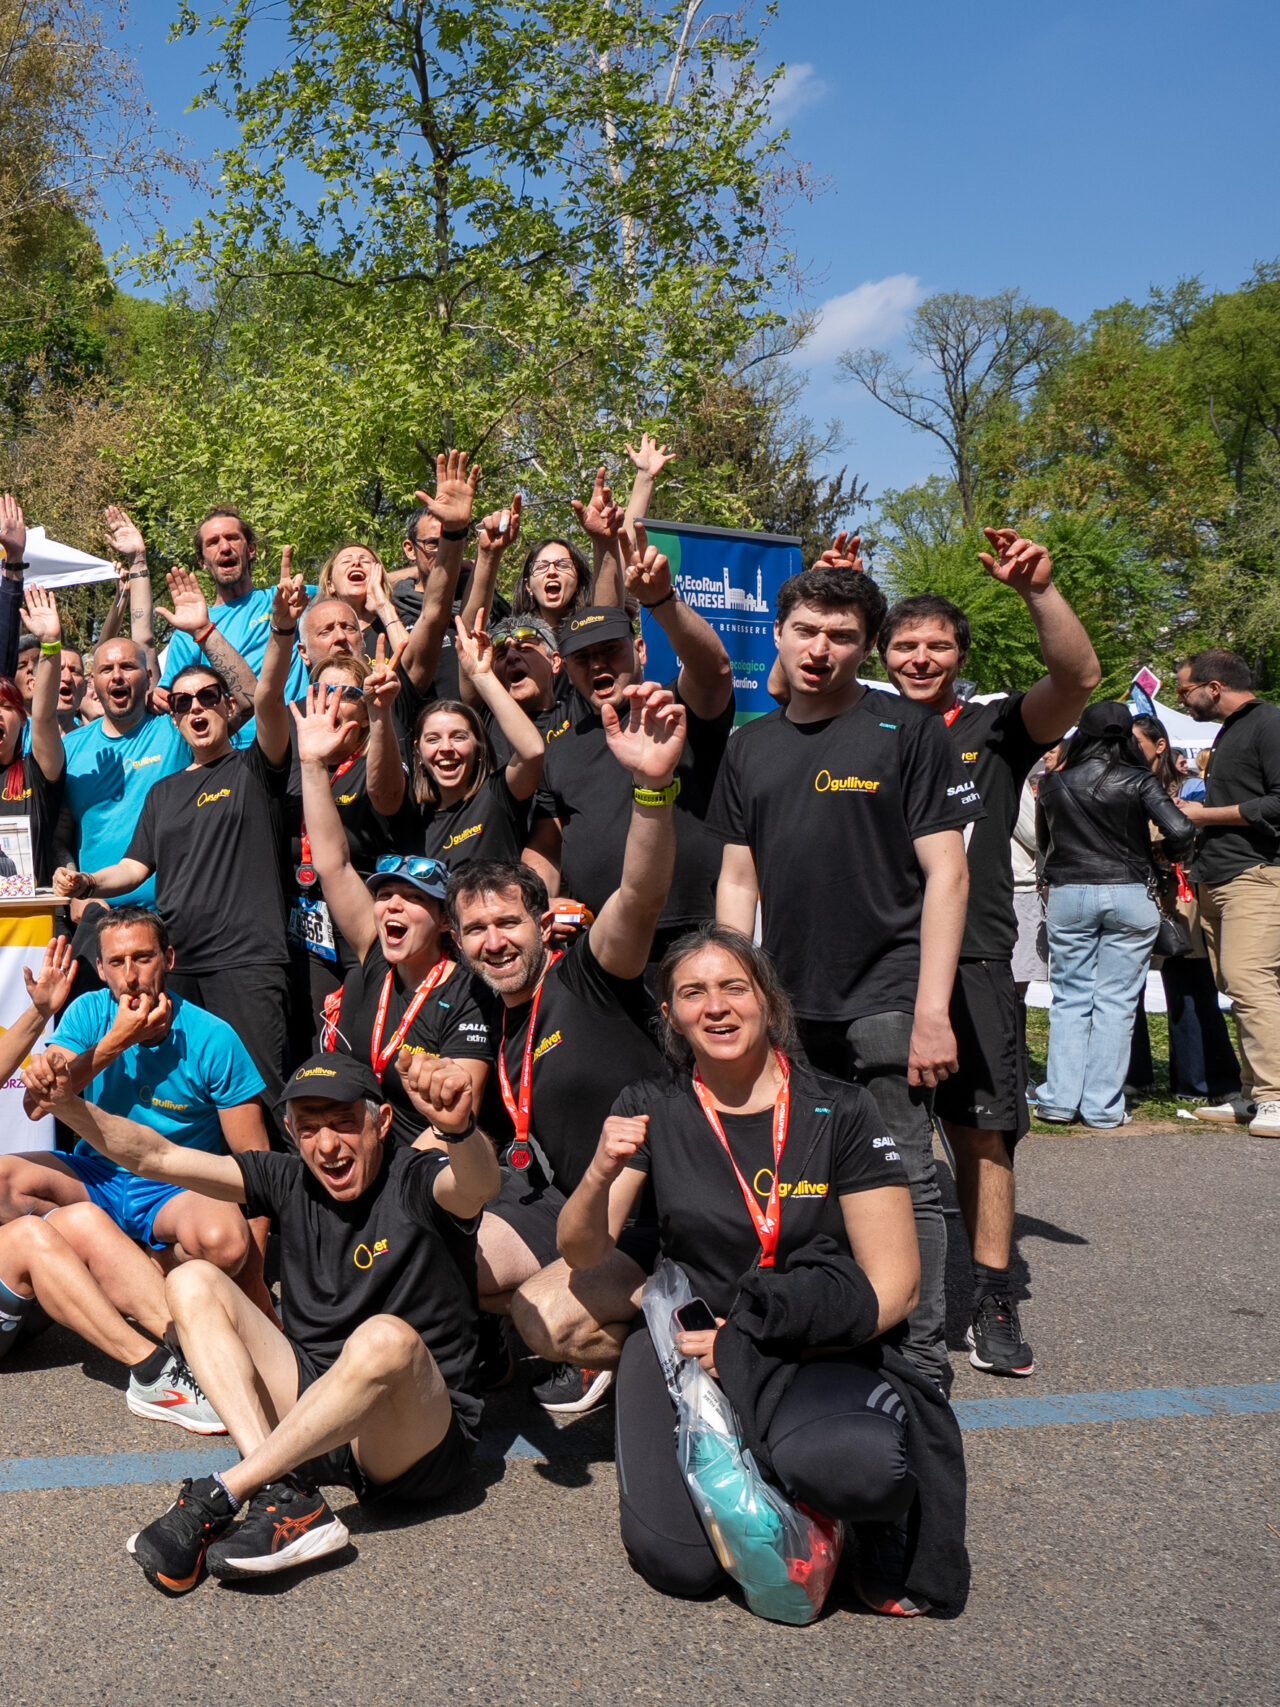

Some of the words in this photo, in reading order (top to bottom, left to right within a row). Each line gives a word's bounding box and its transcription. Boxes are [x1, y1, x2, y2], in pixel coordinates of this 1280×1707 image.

[685, 575, 723, 592] EcoRun
[683, 591, 724, 608] VARESE
[720, 623, 767, 635] BENESSERE
[731, 676, 758, 689] iardino
[830, 776, 881, 791] gulliver
[453, 824, 484, 845] gulliver
[777, 1102, 786, 1142] MARATHON
